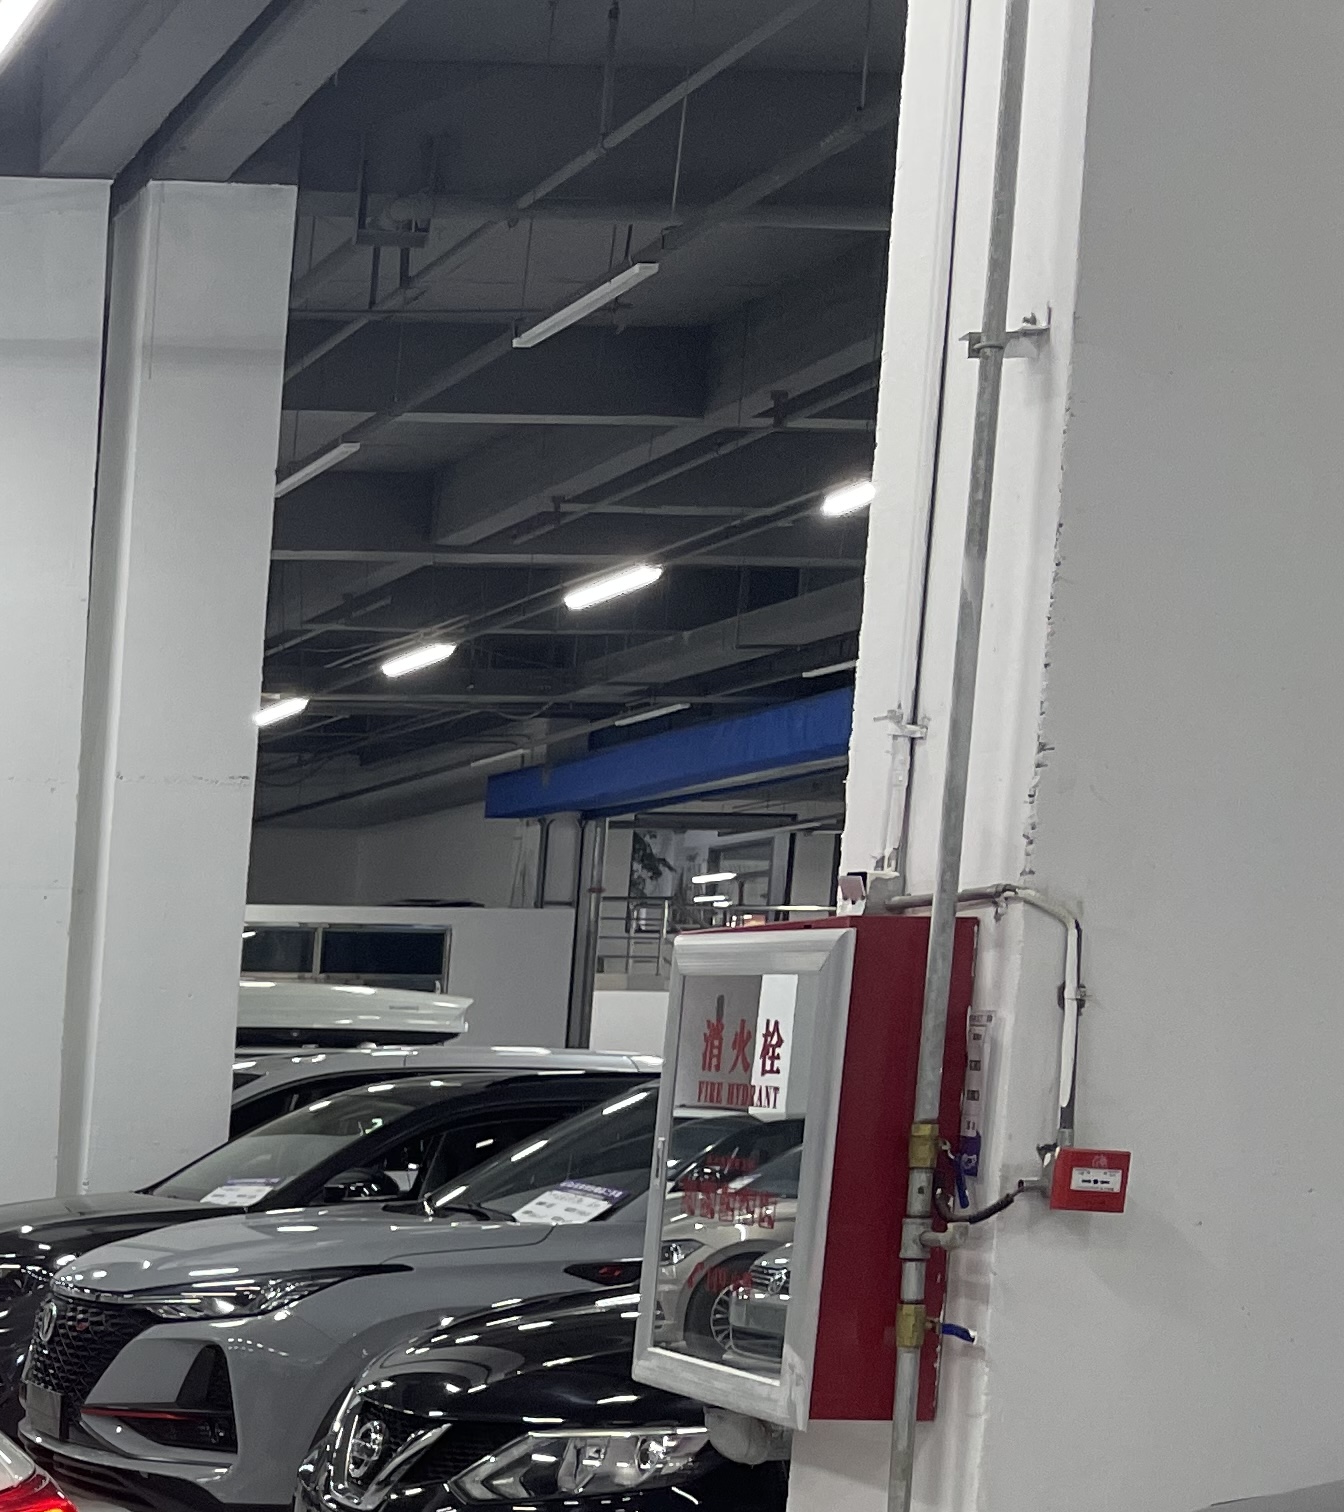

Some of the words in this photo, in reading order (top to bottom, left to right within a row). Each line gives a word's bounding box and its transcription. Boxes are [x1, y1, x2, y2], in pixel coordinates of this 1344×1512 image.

[701, 1018, 784, 1077] 消火栓
[697, 1080, 724, 1104] FIRE
[727, 1083, 780, 1109] HYDRANT
